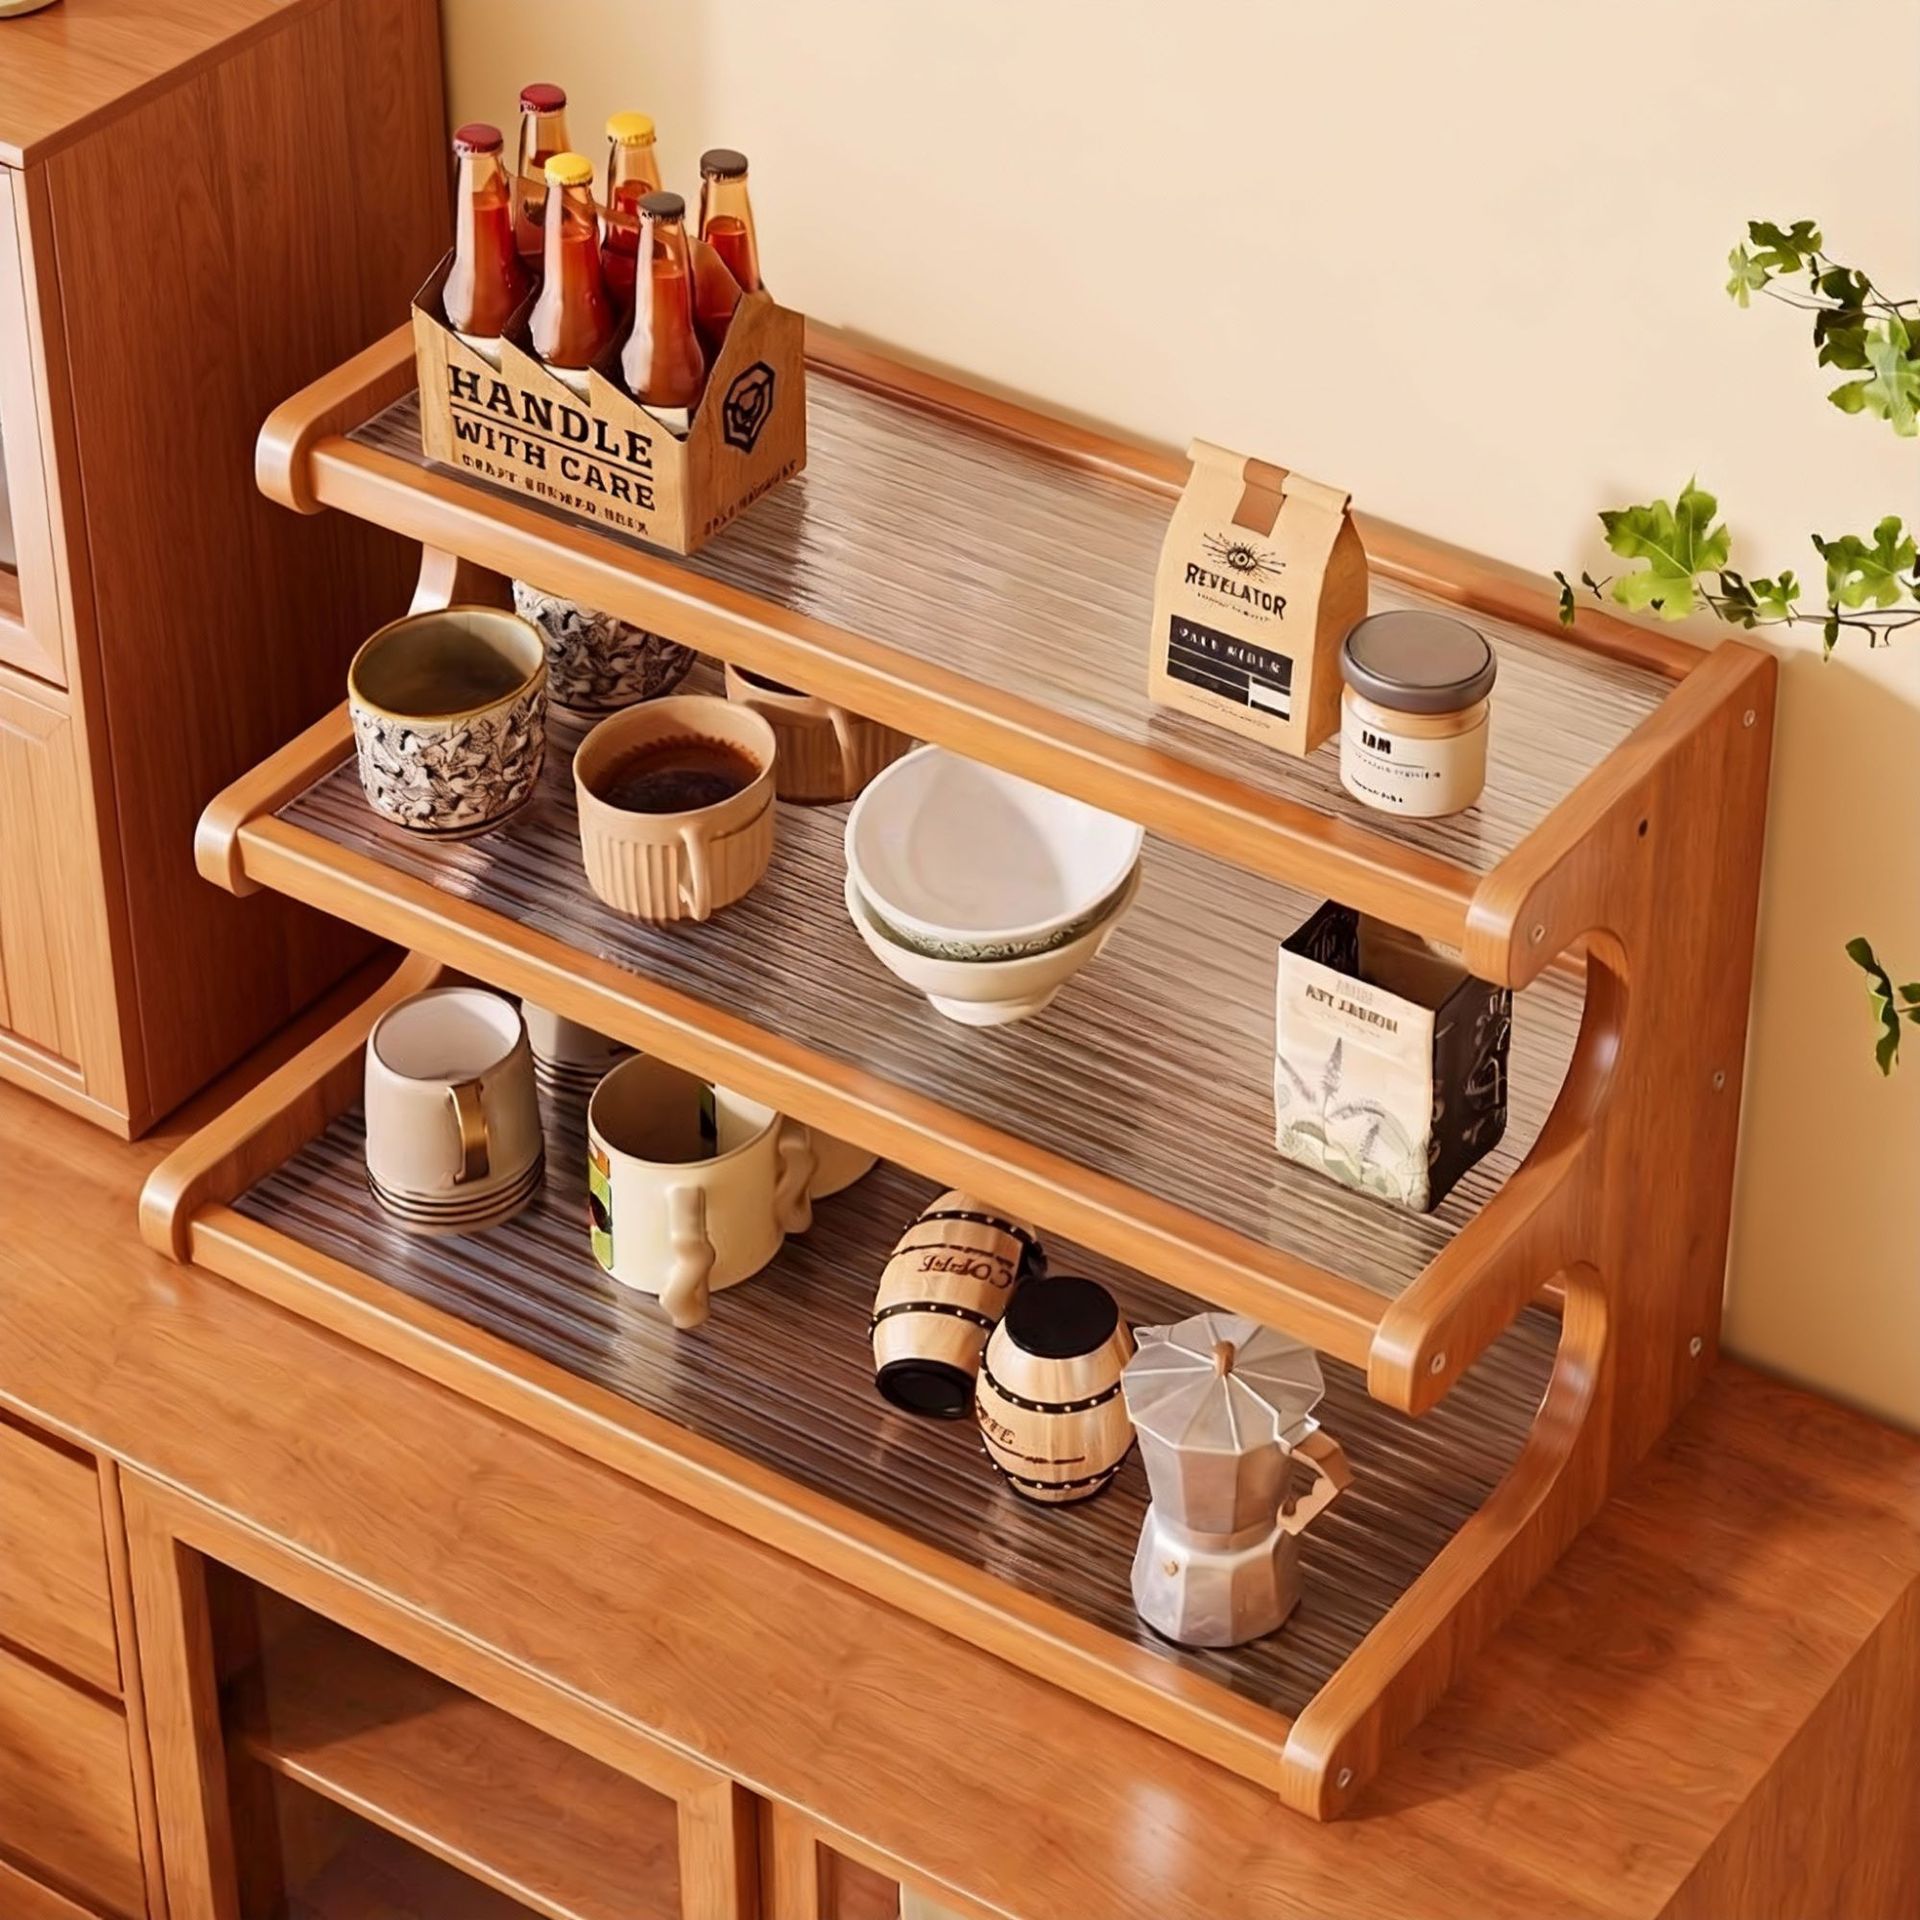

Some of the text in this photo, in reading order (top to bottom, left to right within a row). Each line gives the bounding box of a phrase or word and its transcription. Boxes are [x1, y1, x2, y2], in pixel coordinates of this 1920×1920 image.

[447, 364, 653, 469] HANDLE
[453, 414, 546, 470] WITH
[560, 456, 656, 511] CARE
[1185, 562, 1287, 620] REVELATOR
